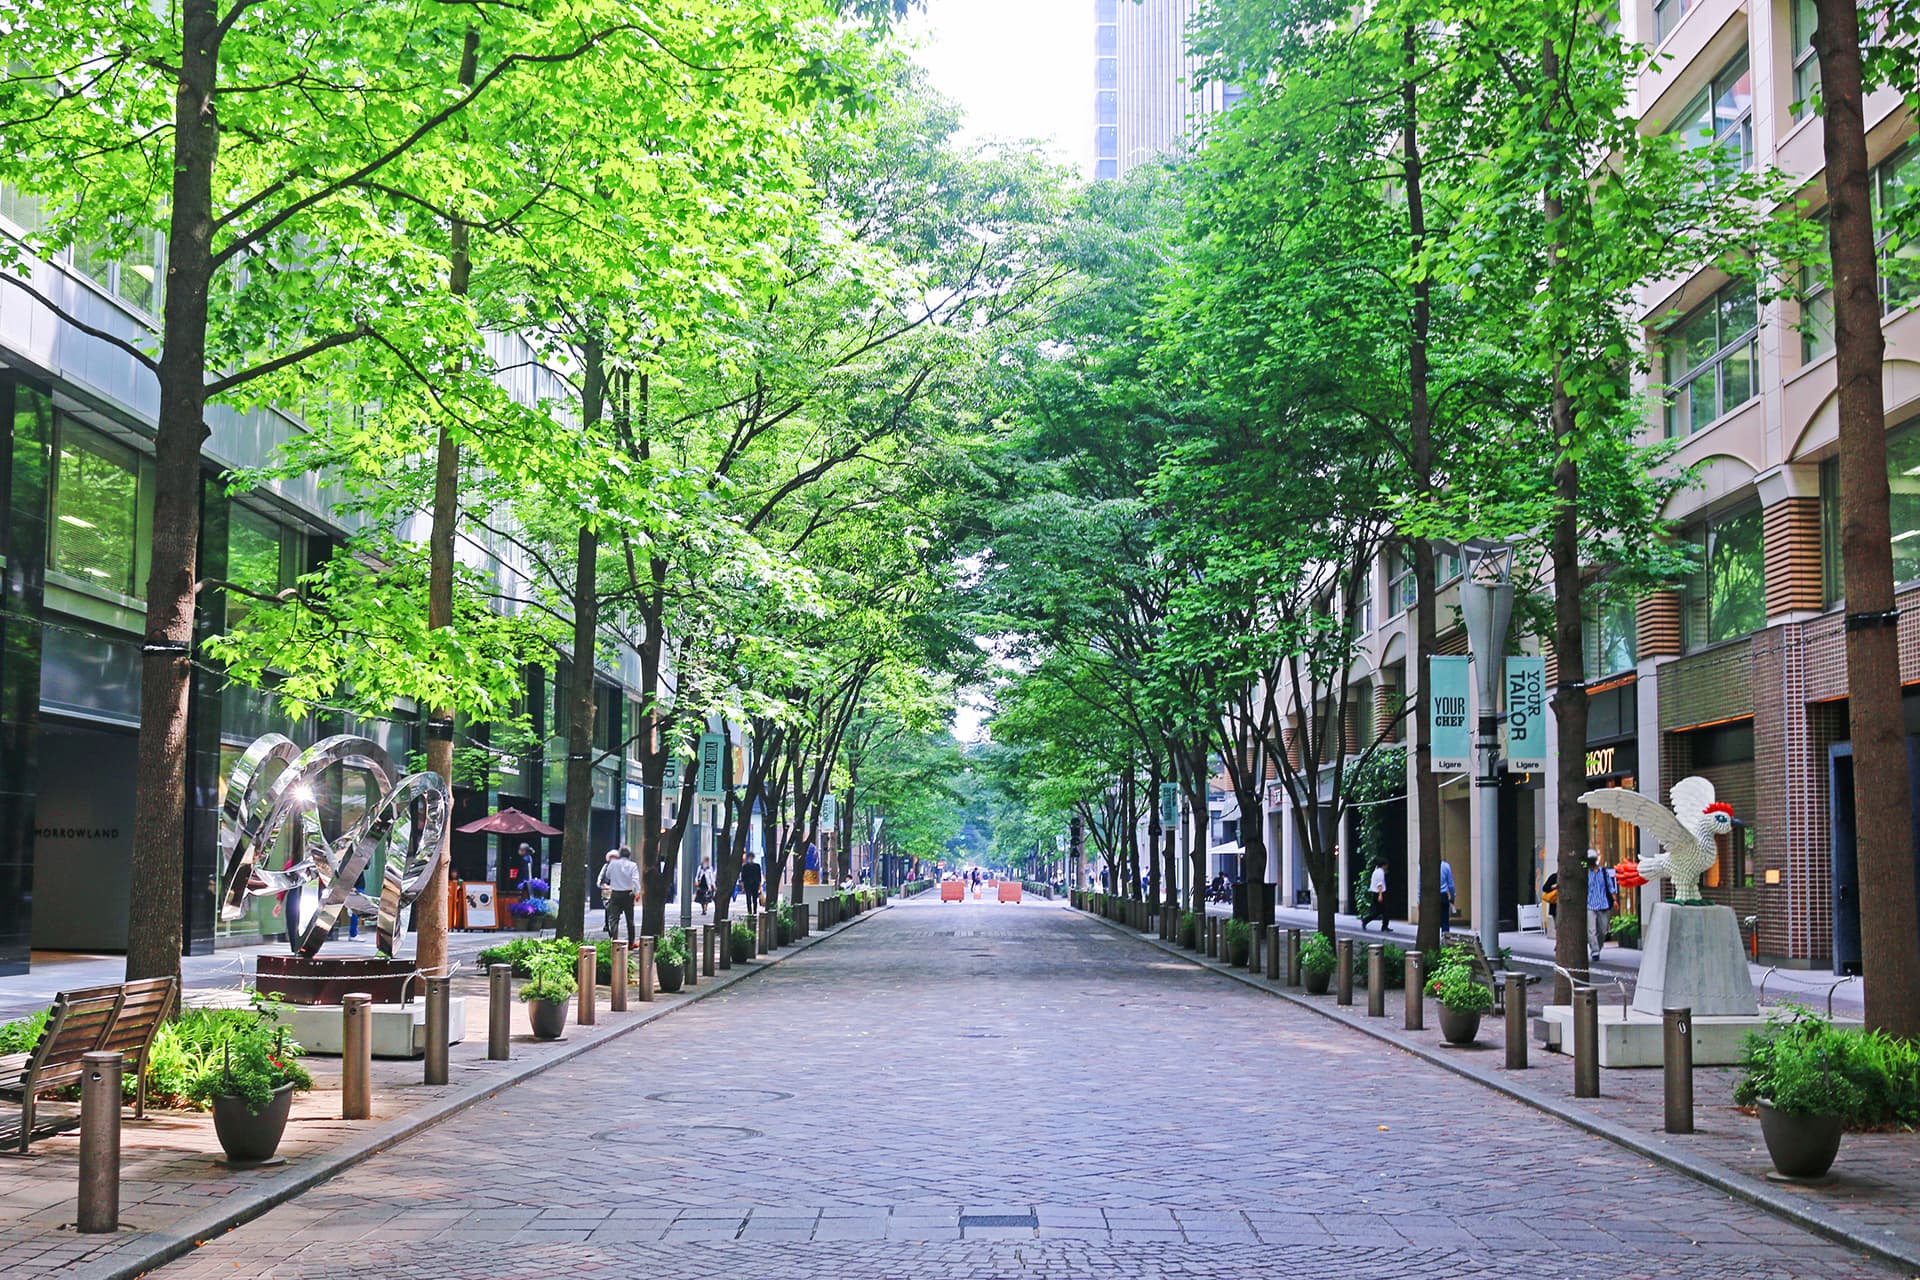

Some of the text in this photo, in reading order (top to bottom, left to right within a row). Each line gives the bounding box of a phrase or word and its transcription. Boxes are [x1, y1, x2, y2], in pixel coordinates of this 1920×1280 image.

[1528, 670, 1540, 717] YOUR
[1434, 696, 1465, 715] YOUR
[1510, 670, 1526, 741] TAILOR
[1435, 716, 1465, 727] CHEF
[1439, 761, 1462, 769] Ligare
[1516, 761, 1539, 769] Ligare
